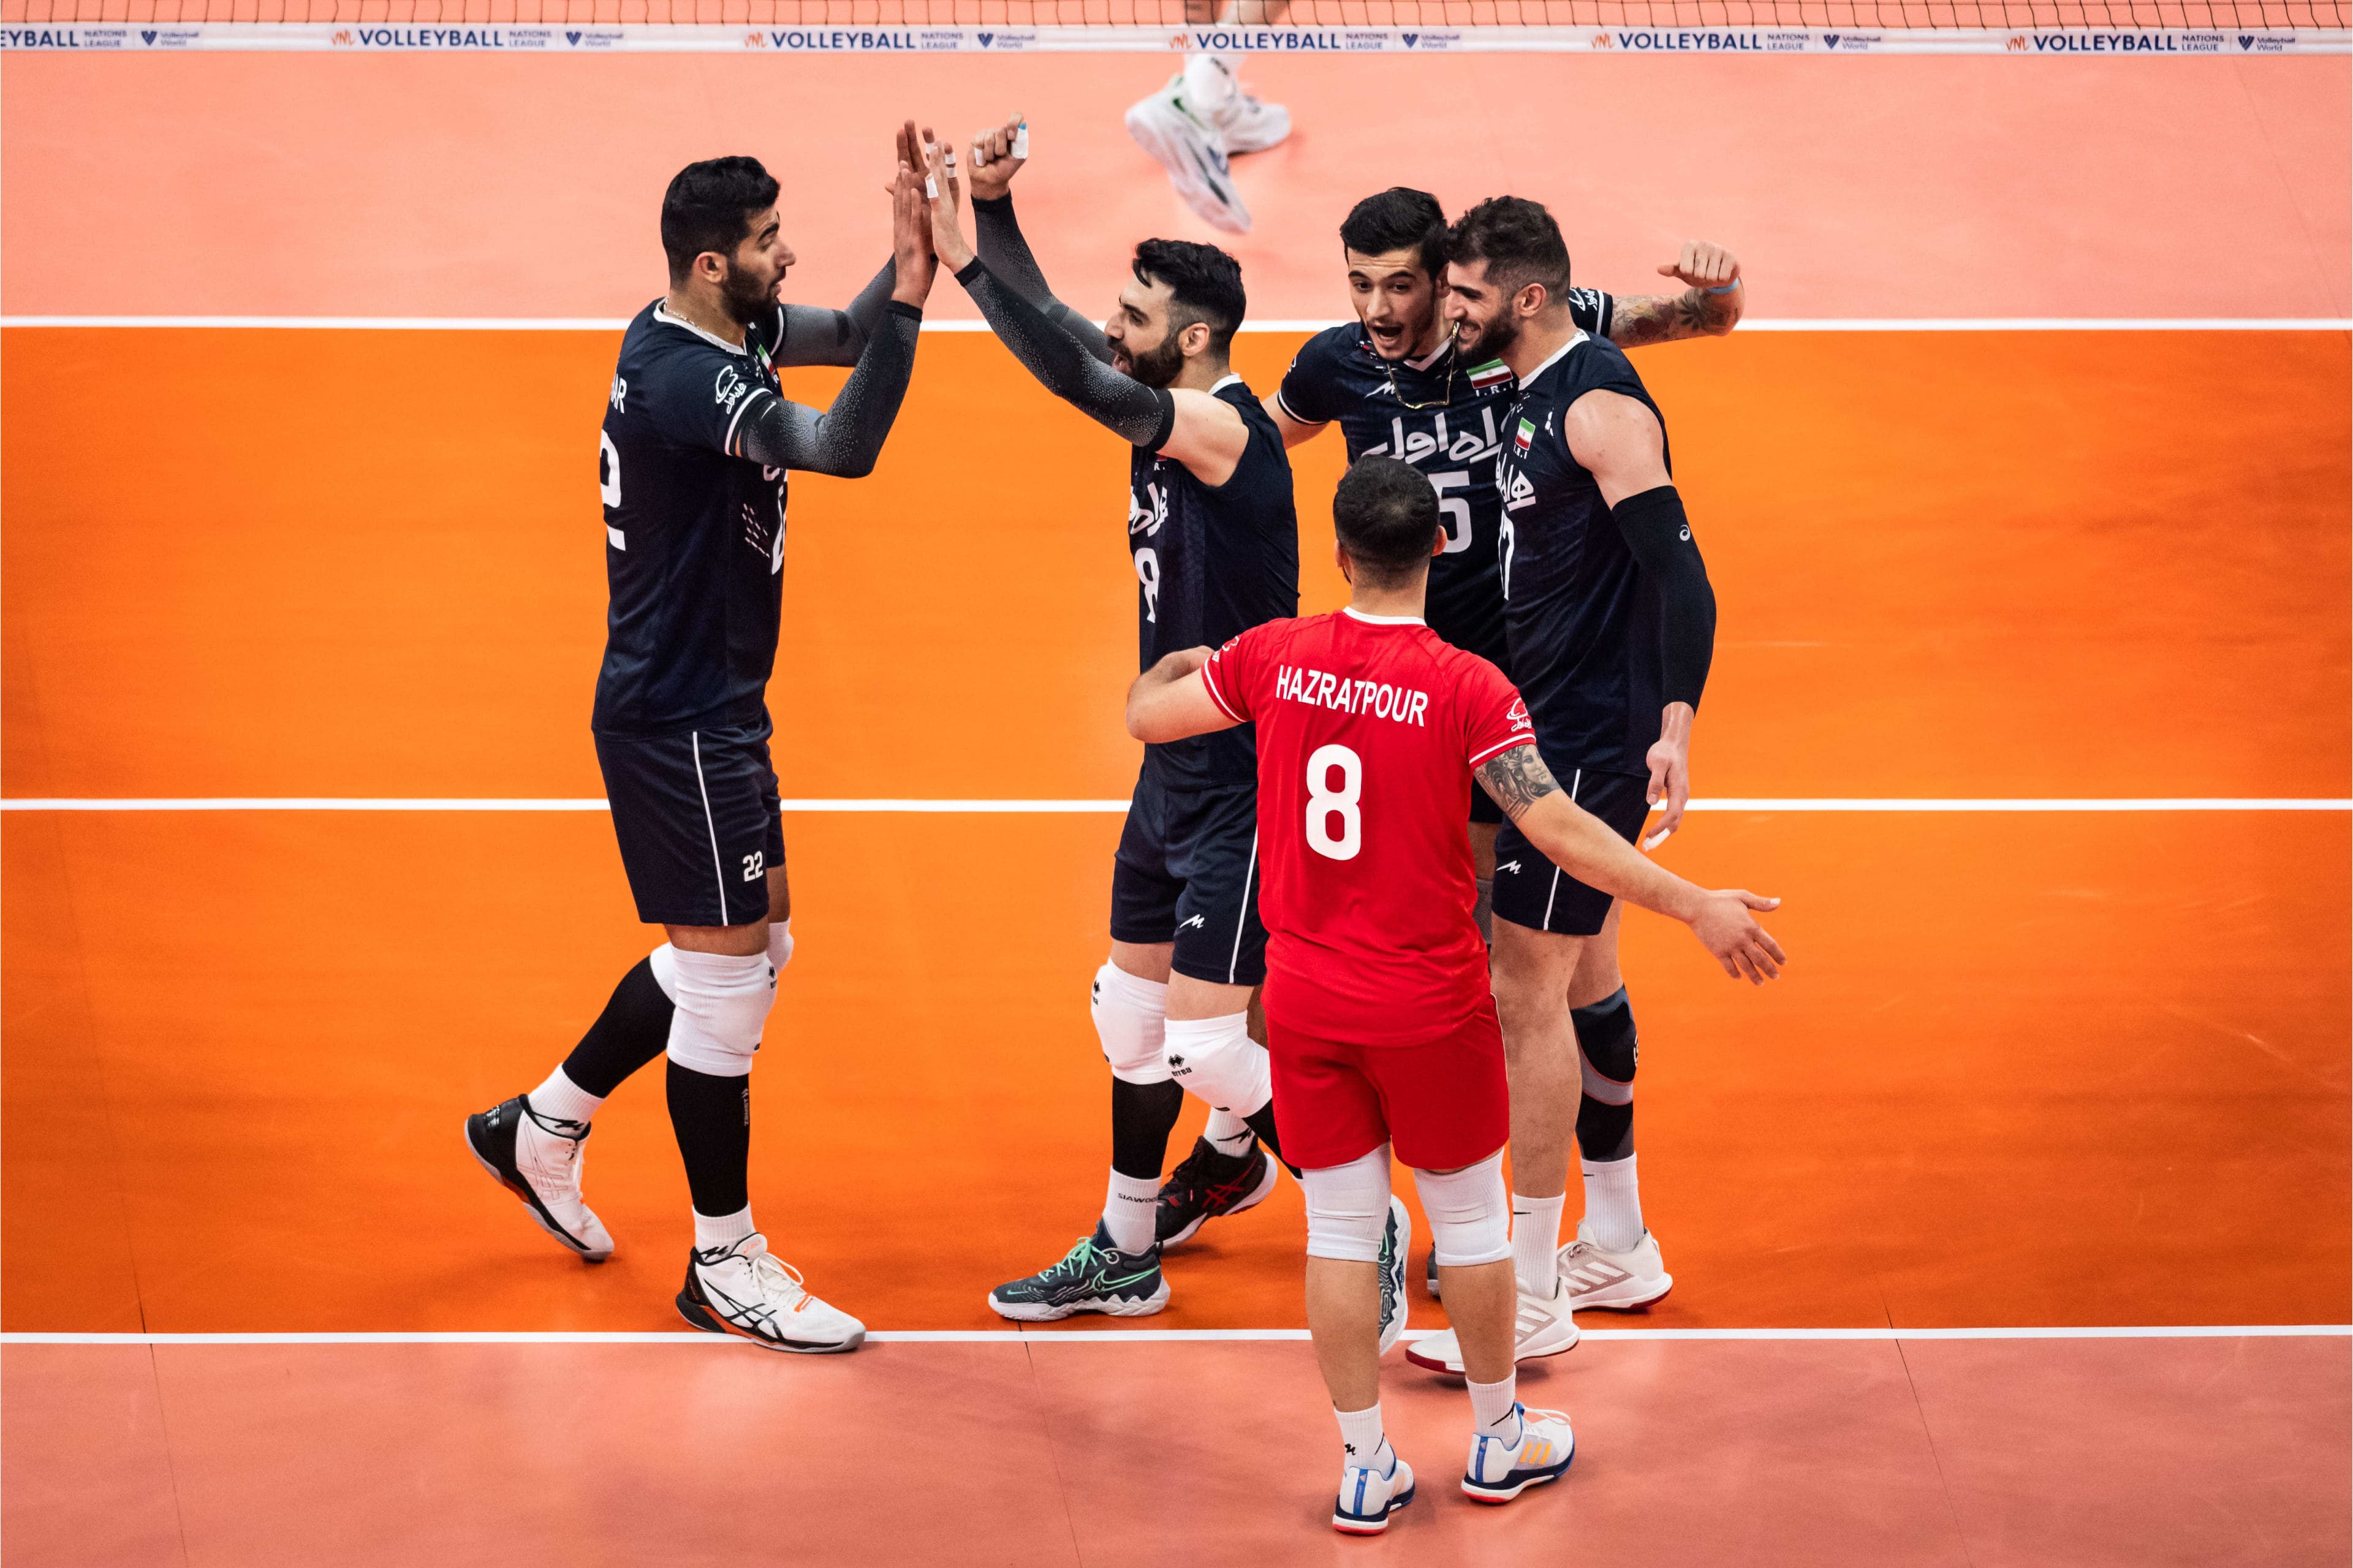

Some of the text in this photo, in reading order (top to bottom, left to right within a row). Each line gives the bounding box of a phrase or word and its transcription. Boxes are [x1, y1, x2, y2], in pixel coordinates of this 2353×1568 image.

[358, 30, 504, 47] VOLLEYBALL
[772, 32, 916, 48] VOLLEYBALL
[1197, 33, 1341, 50] VOLLEYBALL
[1619, 33, 1762, 50] VOLLEYBALL
[2033, 35, 2177, 50] VOLLEYBALL
[1276, 664, 1428, 727] HAZRATPOUR
[1306, 744, 1362, 861] 8
[743, 850, 763, 882] 22
